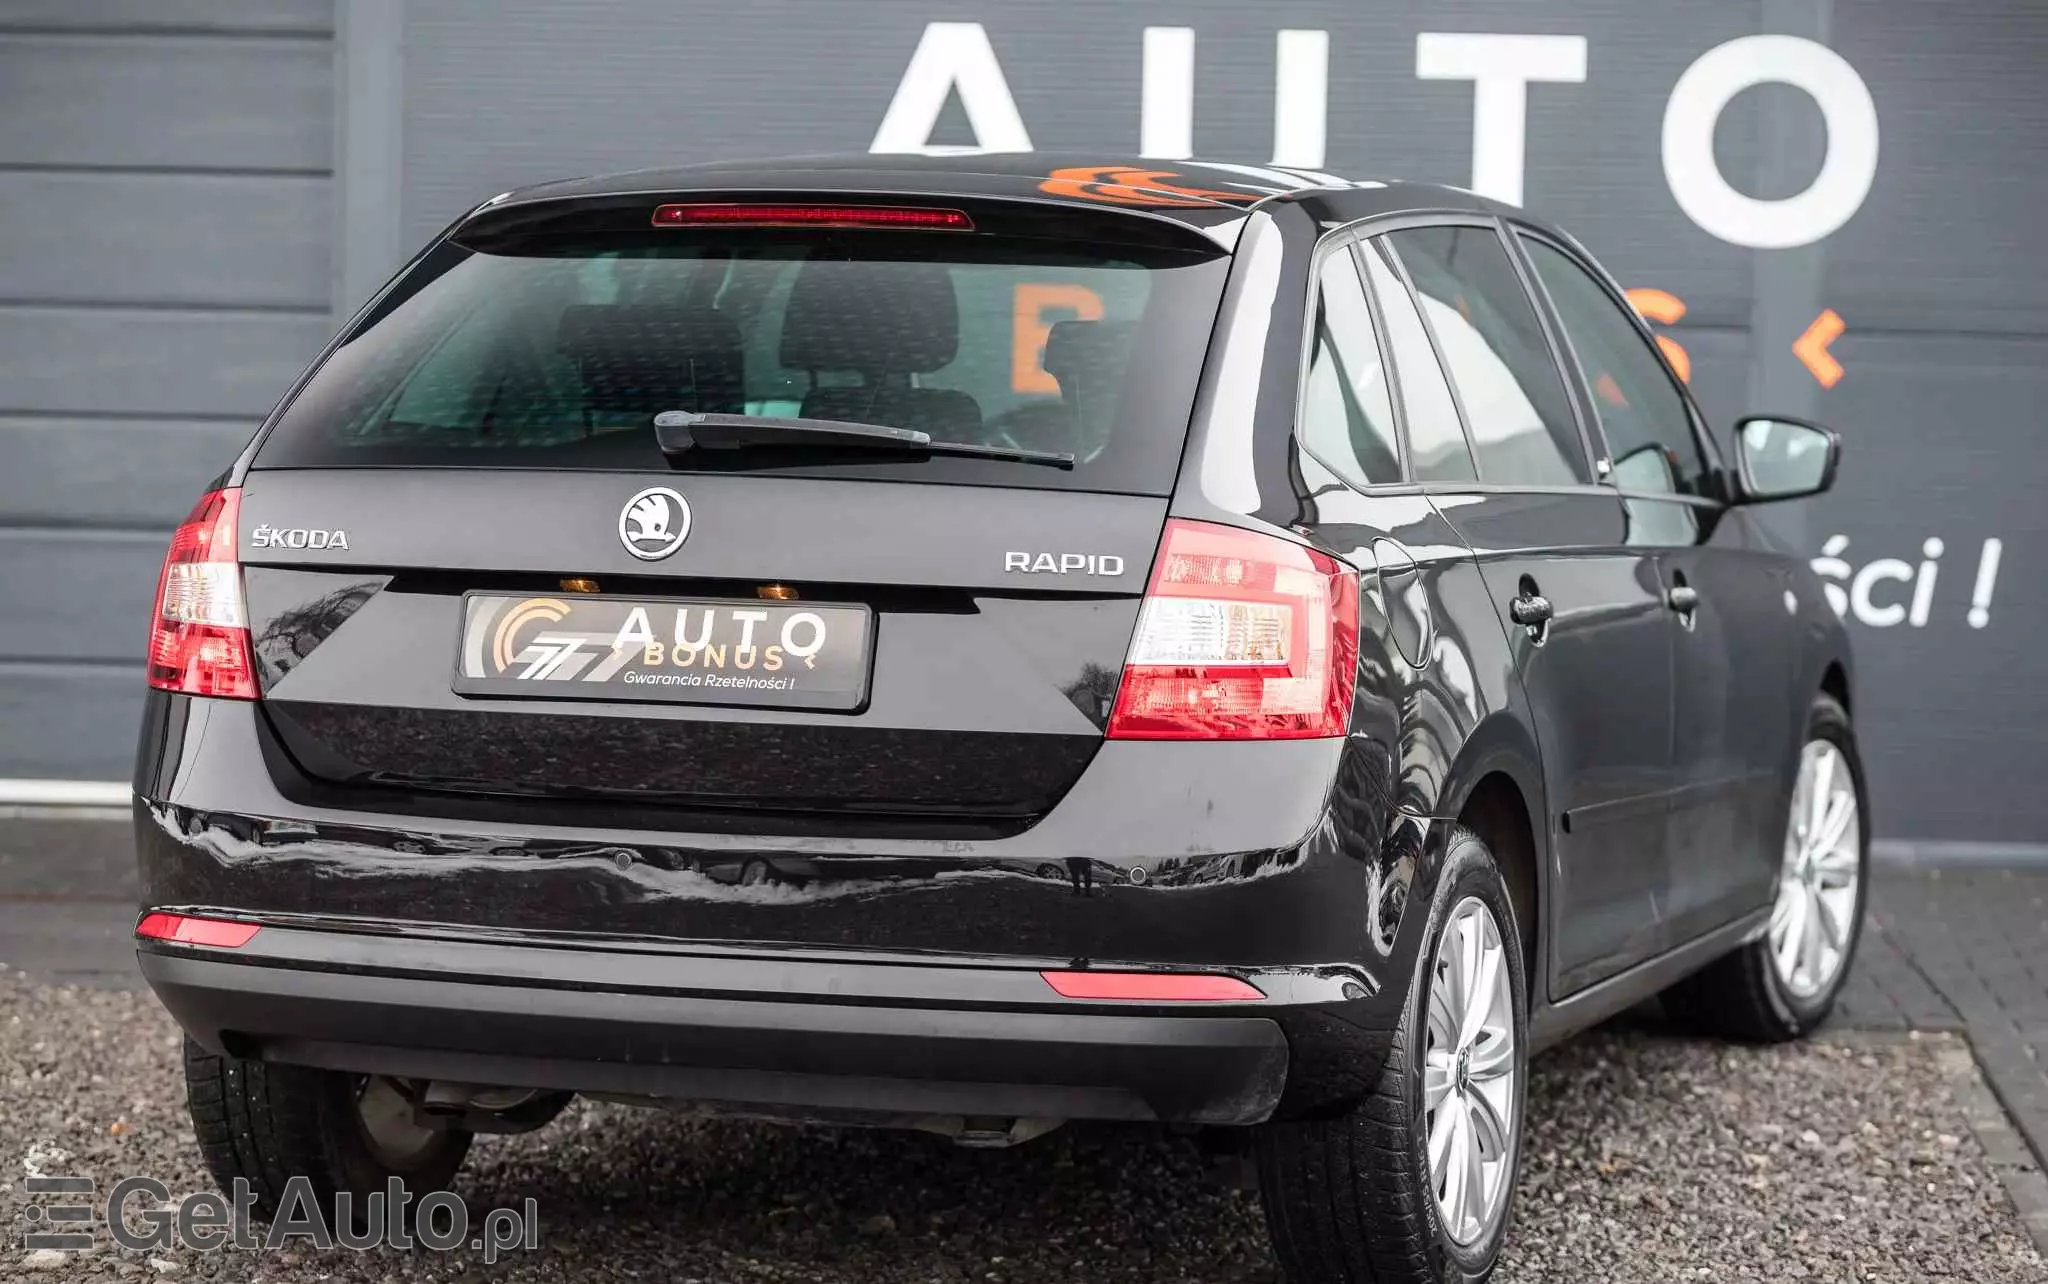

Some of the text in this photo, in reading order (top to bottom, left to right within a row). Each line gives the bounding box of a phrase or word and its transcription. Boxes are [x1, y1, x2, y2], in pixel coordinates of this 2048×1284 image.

[251, 524, 349, 550] ŠKODA
[1005, 551, 1124, 576] RAPID
[611, 606, 827, 657] AUTO
[643, 641, 786, 671] BONUS
[623, 671, 702, 686] Gwarancia
[704, 675, 788, 690] Rzetelności
